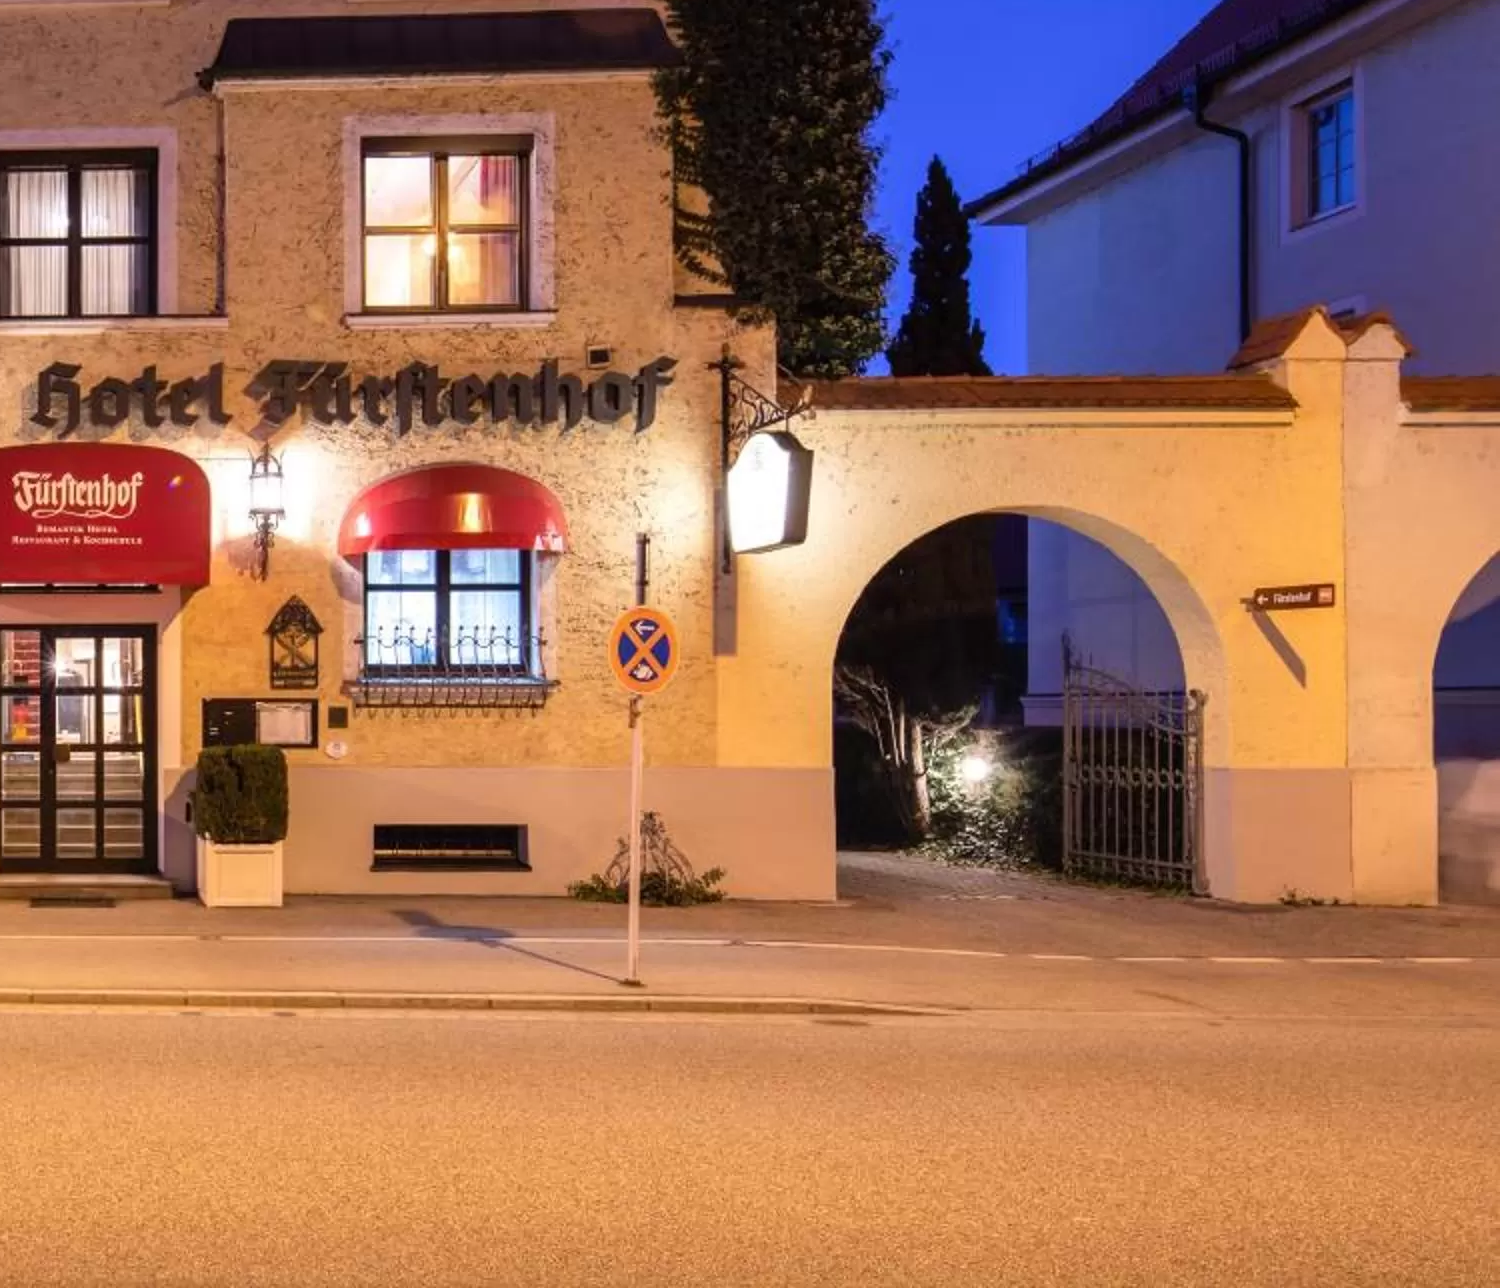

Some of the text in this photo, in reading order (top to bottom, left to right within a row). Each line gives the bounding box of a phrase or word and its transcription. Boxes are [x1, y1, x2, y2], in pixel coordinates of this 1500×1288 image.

[30, 360, 232, 439] Hotel
[11, 471, 144, 519] Fürstenhof
[11, 535, 70, 545] RESTAURANT
[73, 535, 80, 545] &
[87, 524, 118, 533] HOTEL
